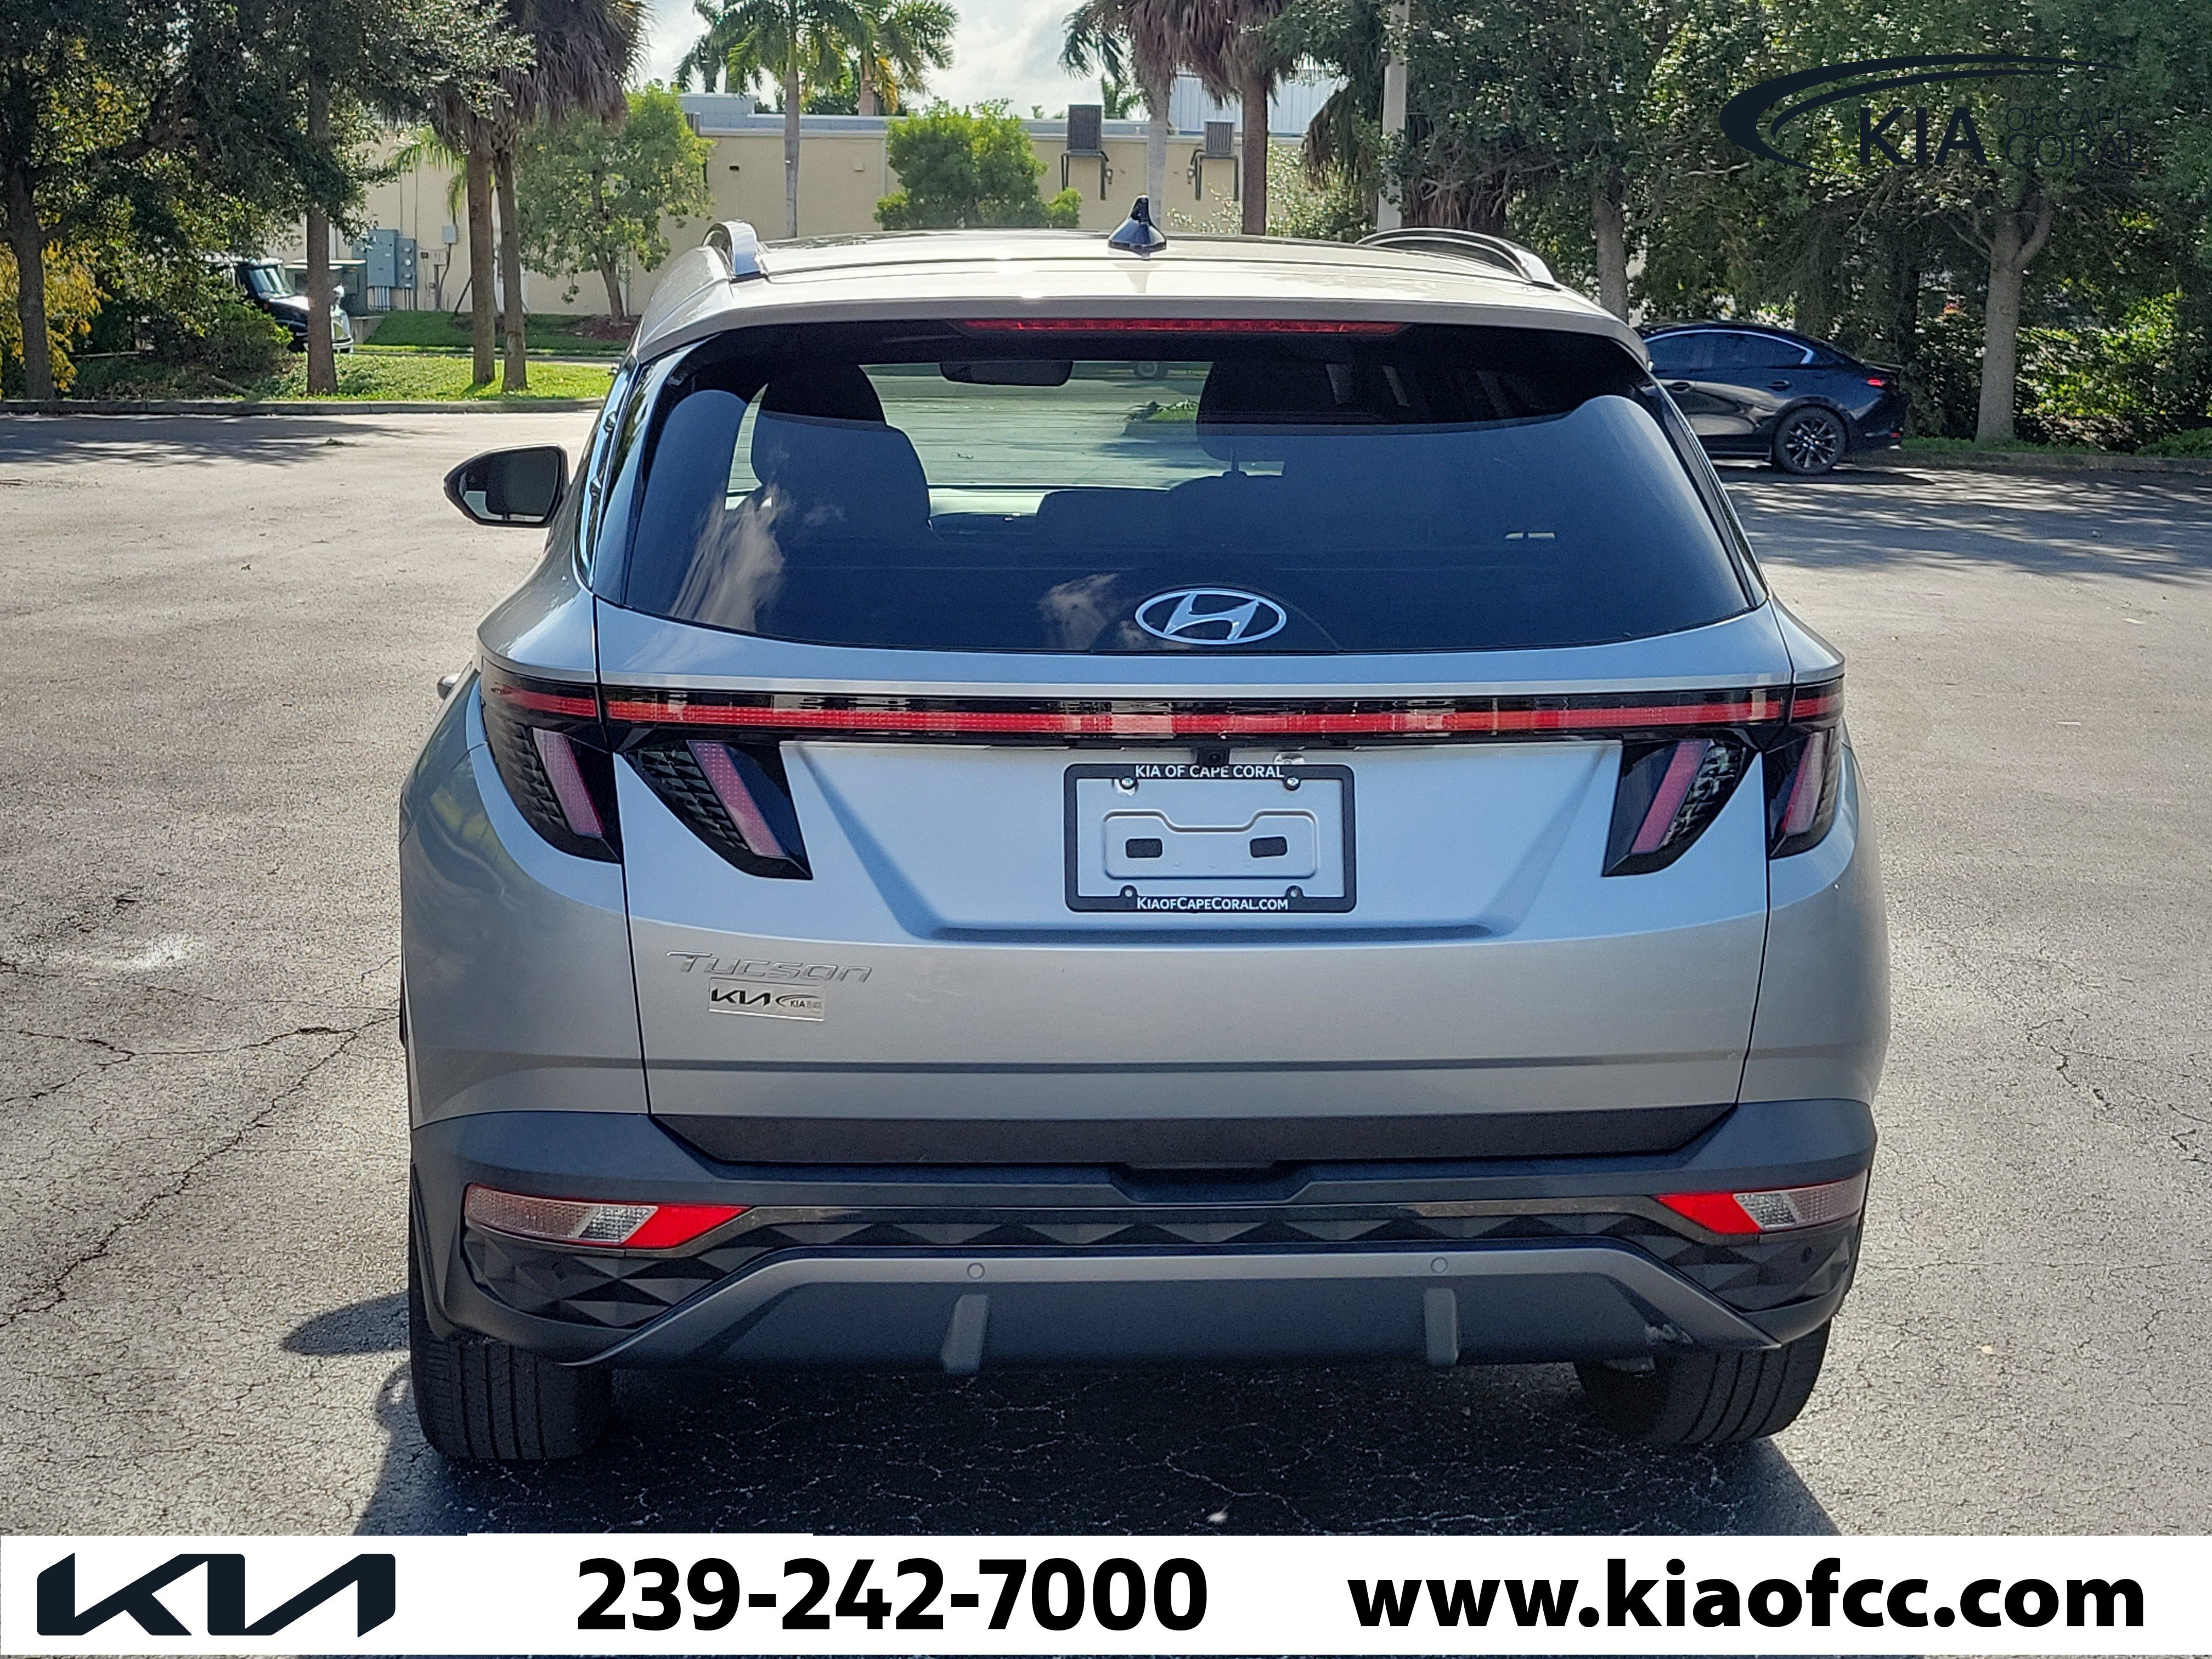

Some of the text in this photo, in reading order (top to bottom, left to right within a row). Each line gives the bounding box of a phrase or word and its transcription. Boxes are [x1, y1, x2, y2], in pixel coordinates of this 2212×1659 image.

[1135, 765, 1285, 778] KIA OF CAPE CORAL
[790, 1000, 806, 1008] KIA
